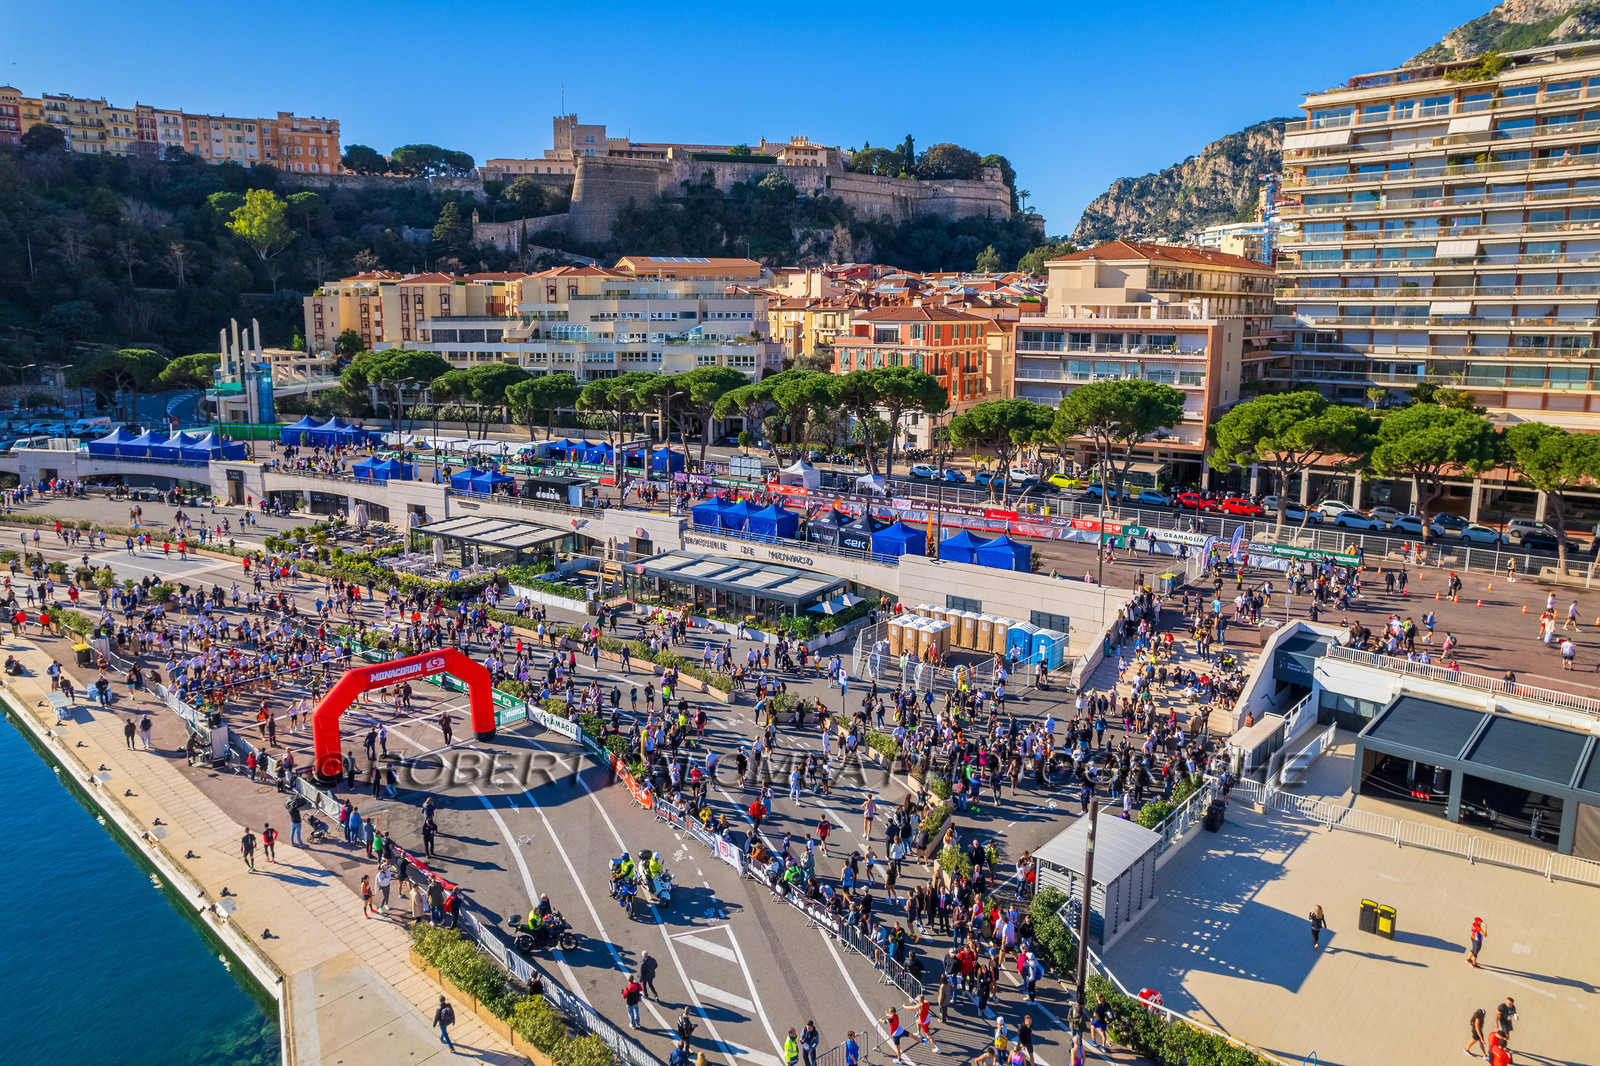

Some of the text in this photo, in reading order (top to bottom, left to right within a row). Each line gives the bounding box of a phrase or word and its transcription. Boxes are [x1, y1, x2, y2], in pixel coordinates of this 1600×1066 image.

[844, 538, 866, 550] 42K
[1163, 532, 1204, 543] GRAMAGLIA
[683, 535, 814, 566] BRASSERIE DE MONACO
[370, 663, 423, 683] MONACORUN
